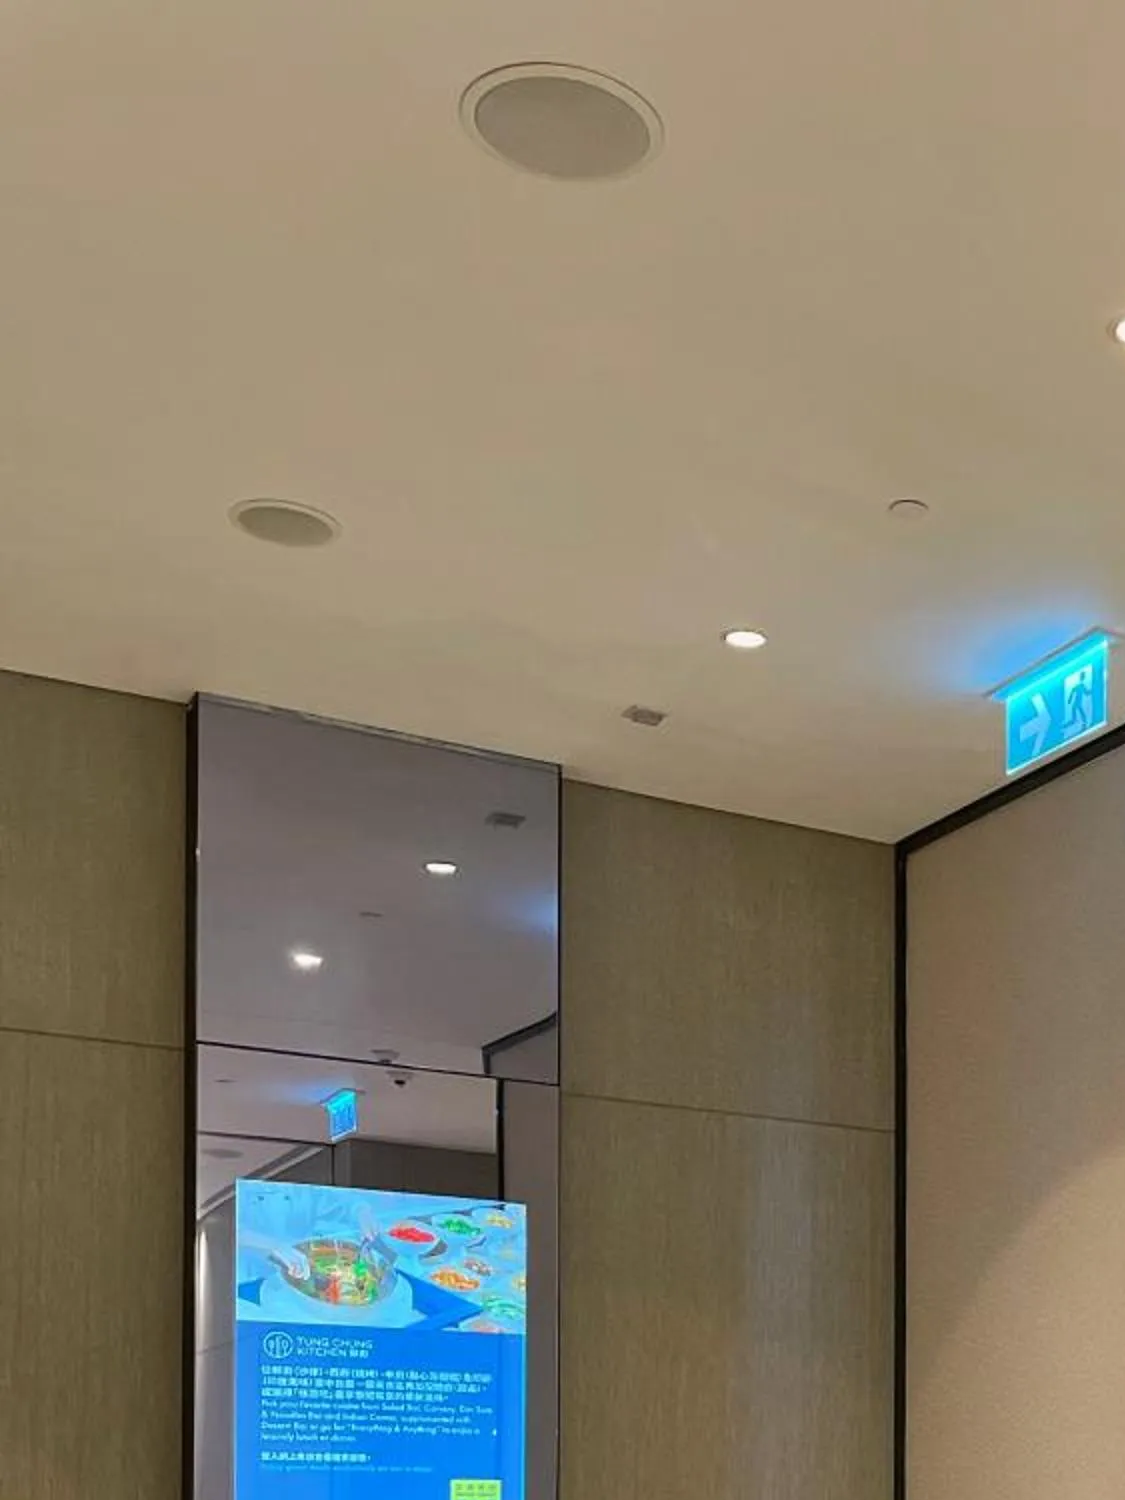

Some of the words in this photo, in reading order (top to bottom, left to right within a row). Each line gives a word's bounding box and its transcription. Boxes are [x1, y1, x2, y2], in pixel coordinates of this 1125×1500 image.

[296, 1336, 329, 1347] TUNG
[331, 1338, 374, 1350] CHUNG
[296, 1347, 348, 1358] KITCHEN
